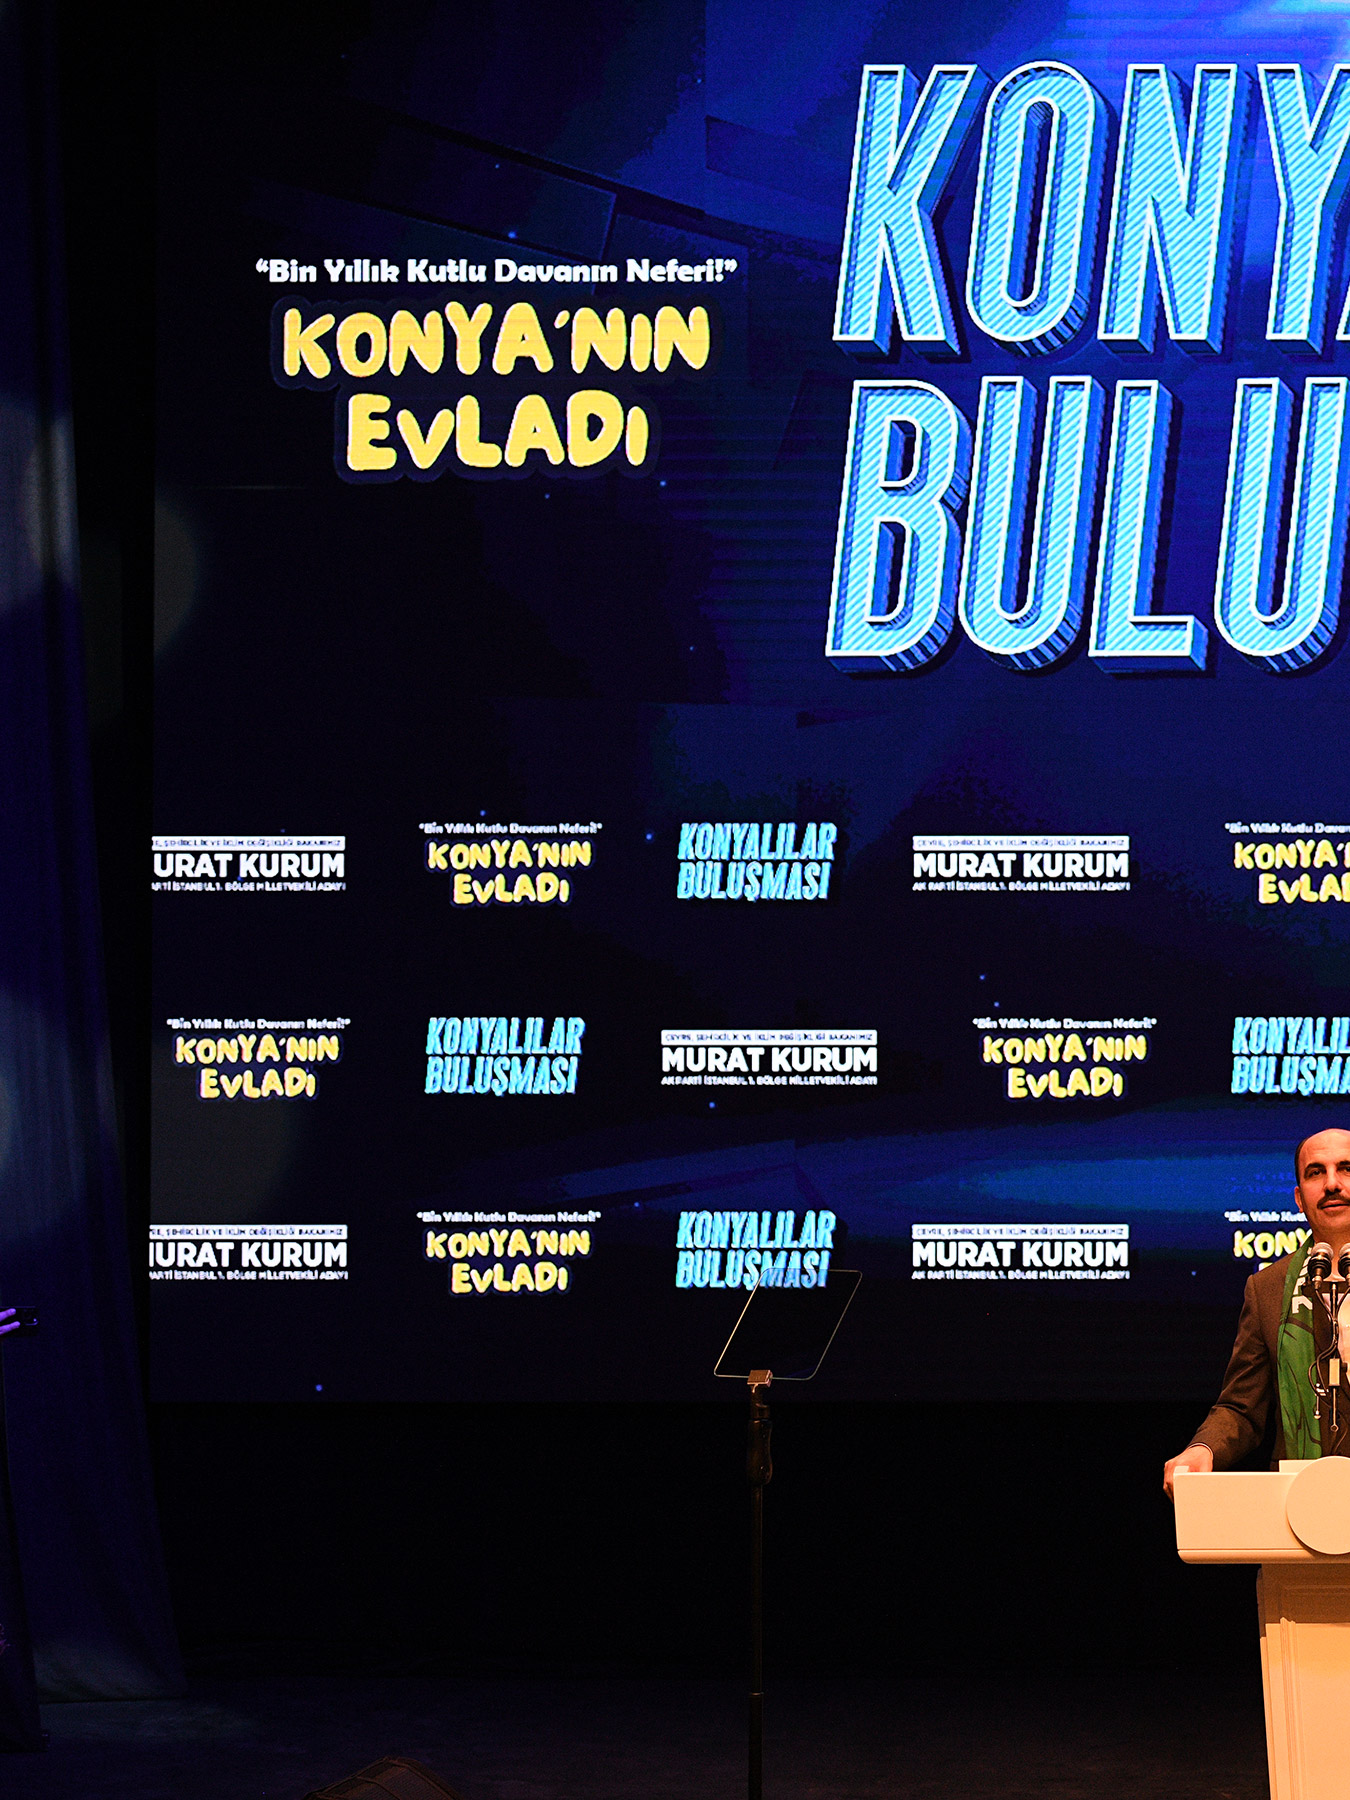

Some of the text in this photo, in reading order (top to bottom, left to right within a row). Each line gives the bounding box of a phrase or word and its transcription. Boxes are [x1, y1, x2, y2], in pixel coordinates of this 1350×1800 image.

[256, 258, 737, 282] “Bin Yıllık Kutlu Davanın Neferi!”
[284, 302, 709, 378] KONYA'NIN
[678, 823, 837, 862] KONYALILAR
[154, 853, 344, 877] URAT KURUM
[677, 861, 831, 901] BULUŞMASI
[914, 853, 1128, 877] MURAT KURUM
[426, 1017, 585, 1055] KONYALILAR
[424, 1056, 578, 1096] BULUŞMASI
[662, 1047, 877, 1072] MURAT KURUM
[676, 1210, 836, 1251] KONYALILAR
[149, 1242, 347, 1267] URAT KURUM
[676, 1249, 830, 1292] BULUŞMASI
[913, 1242, 1128, 1267] MURAT KURUM
